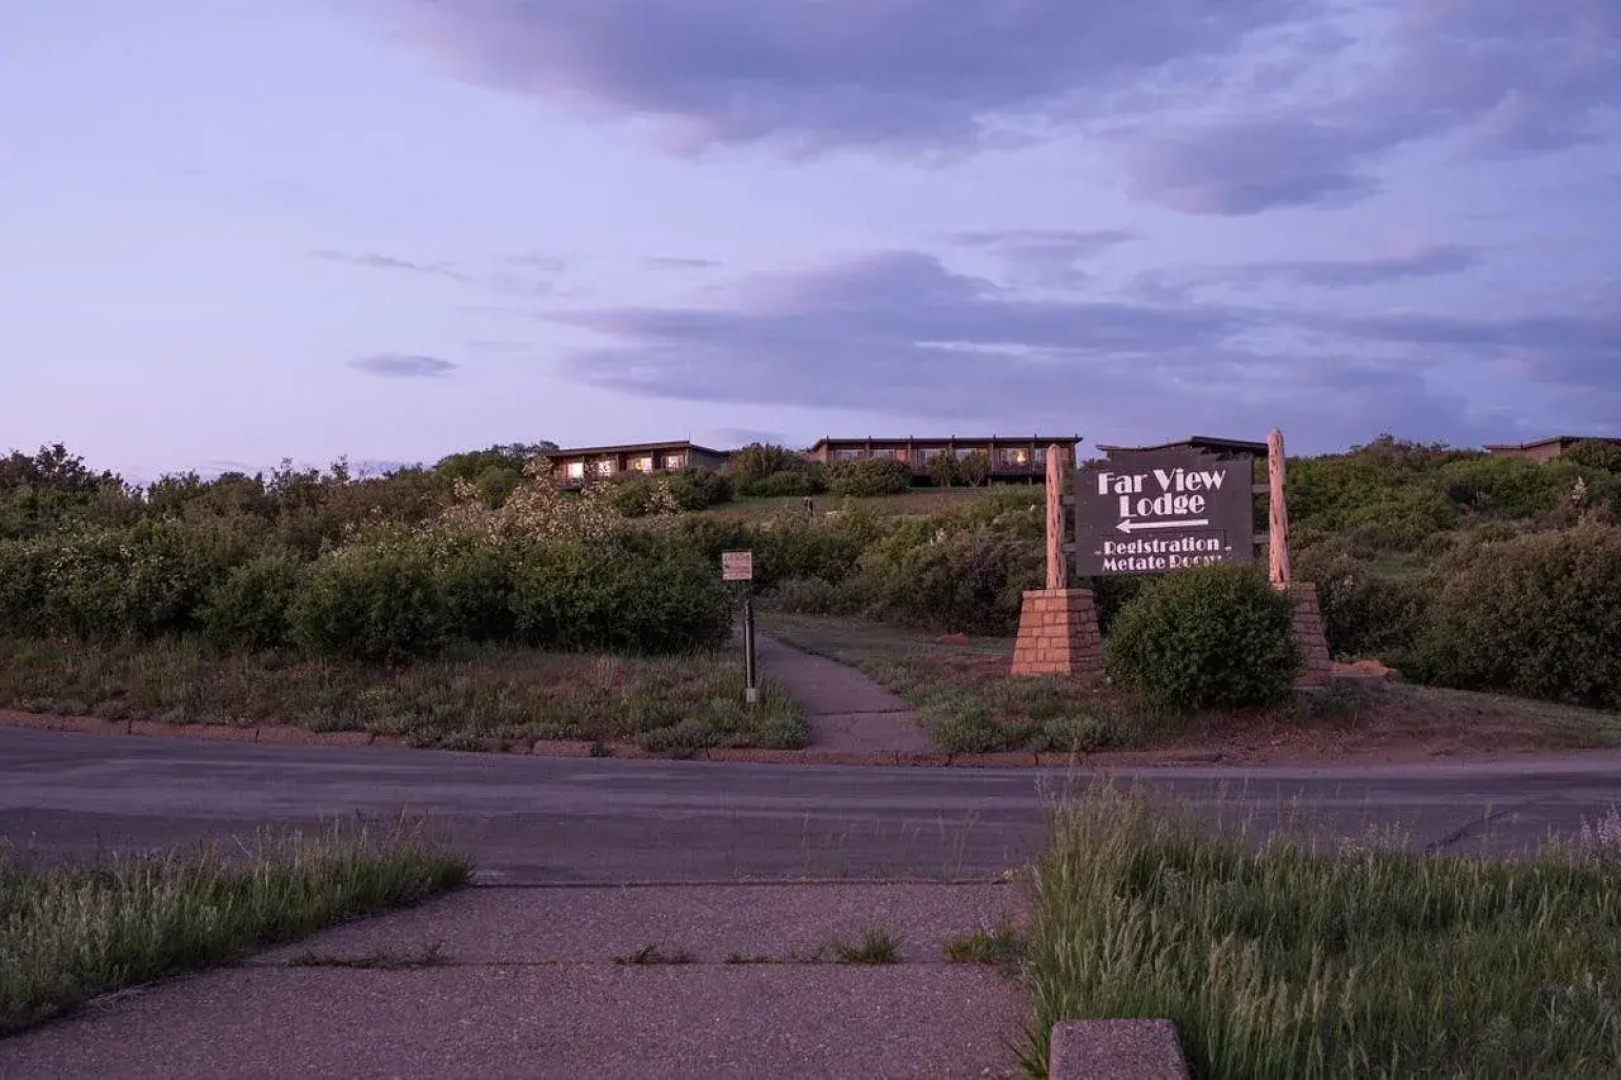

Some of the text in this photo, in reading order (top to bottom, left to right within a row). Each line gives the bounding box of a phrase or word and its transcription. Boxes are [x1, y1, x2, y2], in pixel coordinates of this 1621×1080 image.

[1098, 468, 1226, 495] Far View
[1119, 493, 1205, 517] Lodge
[1104, 537, 1219, 555] Registration
[1103, 555, 1165, 571] Metate
